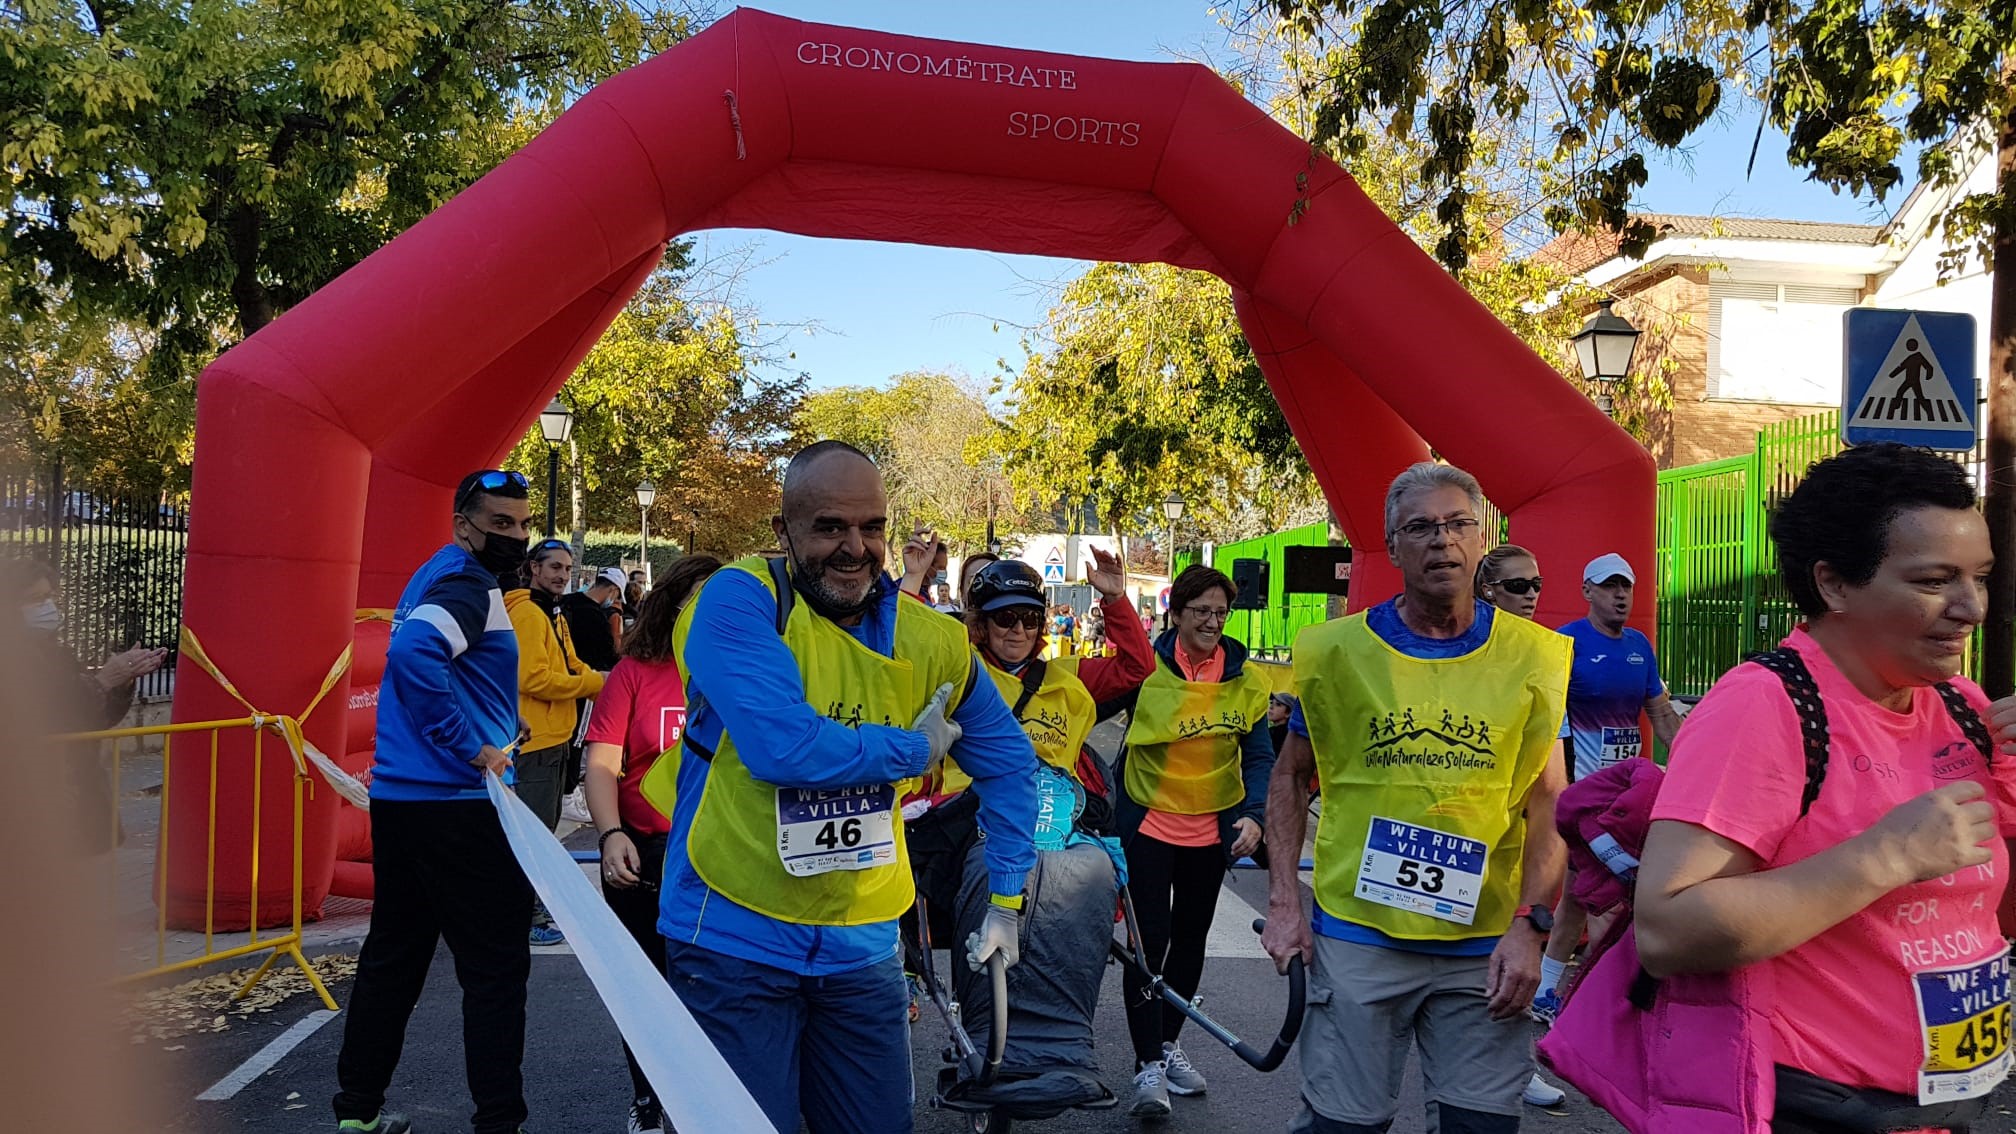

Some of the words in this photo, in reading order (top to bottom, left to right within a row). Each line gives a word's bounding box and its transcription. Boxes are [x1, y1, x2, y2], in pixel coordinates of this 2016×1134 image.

[797, 41, 1076, 90] CRONOMÉTRATE
[1007, 111, 1140, 147] SPORTS
[1613, 745, 1637, 759] 154
[797, 789, 828, 802] WE
[815, 817, 862, 850] 46
[1390, 823, 1420, 841] WE
[1431, 834, 1473, 854] RUN
[1395, 859, 1445, 894] 53
[1895, 898, 1940, 926] FOR
[1970, 893, 1985, 913] A
[1900, 926, 1984, 968] REASON
[1947, 968, 1981, 993] WE
[1989, 955, 2010, 980] RU
[1955, 1004, 2012, 1064] 456
